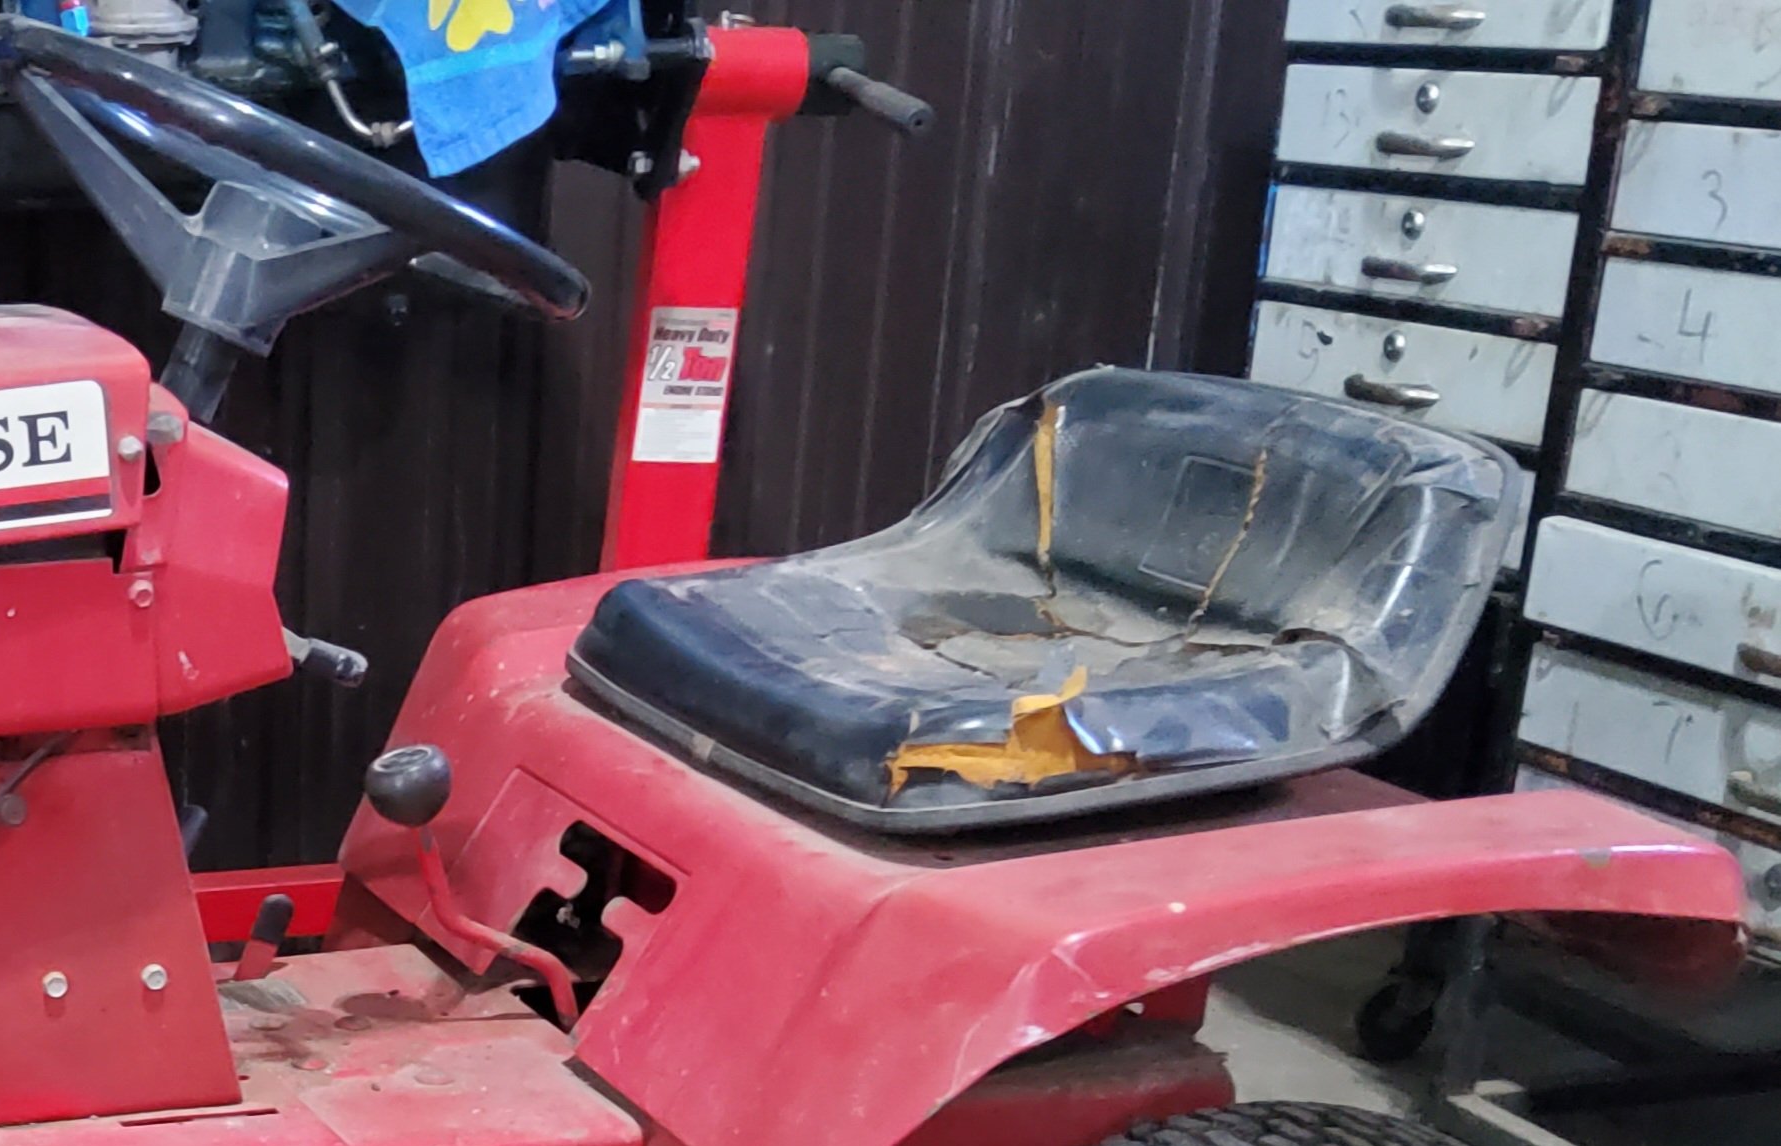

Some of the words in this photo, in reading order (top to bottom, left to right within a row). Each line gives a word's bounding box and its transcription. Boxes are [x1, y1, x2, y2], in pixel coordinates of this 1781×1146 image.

[1701, 169, 1728, 232] 3
[653, 326, 696, 343] Heavy
[697, 327, 731, 345] Duty
[1677, 288, 1714, 363] 4
